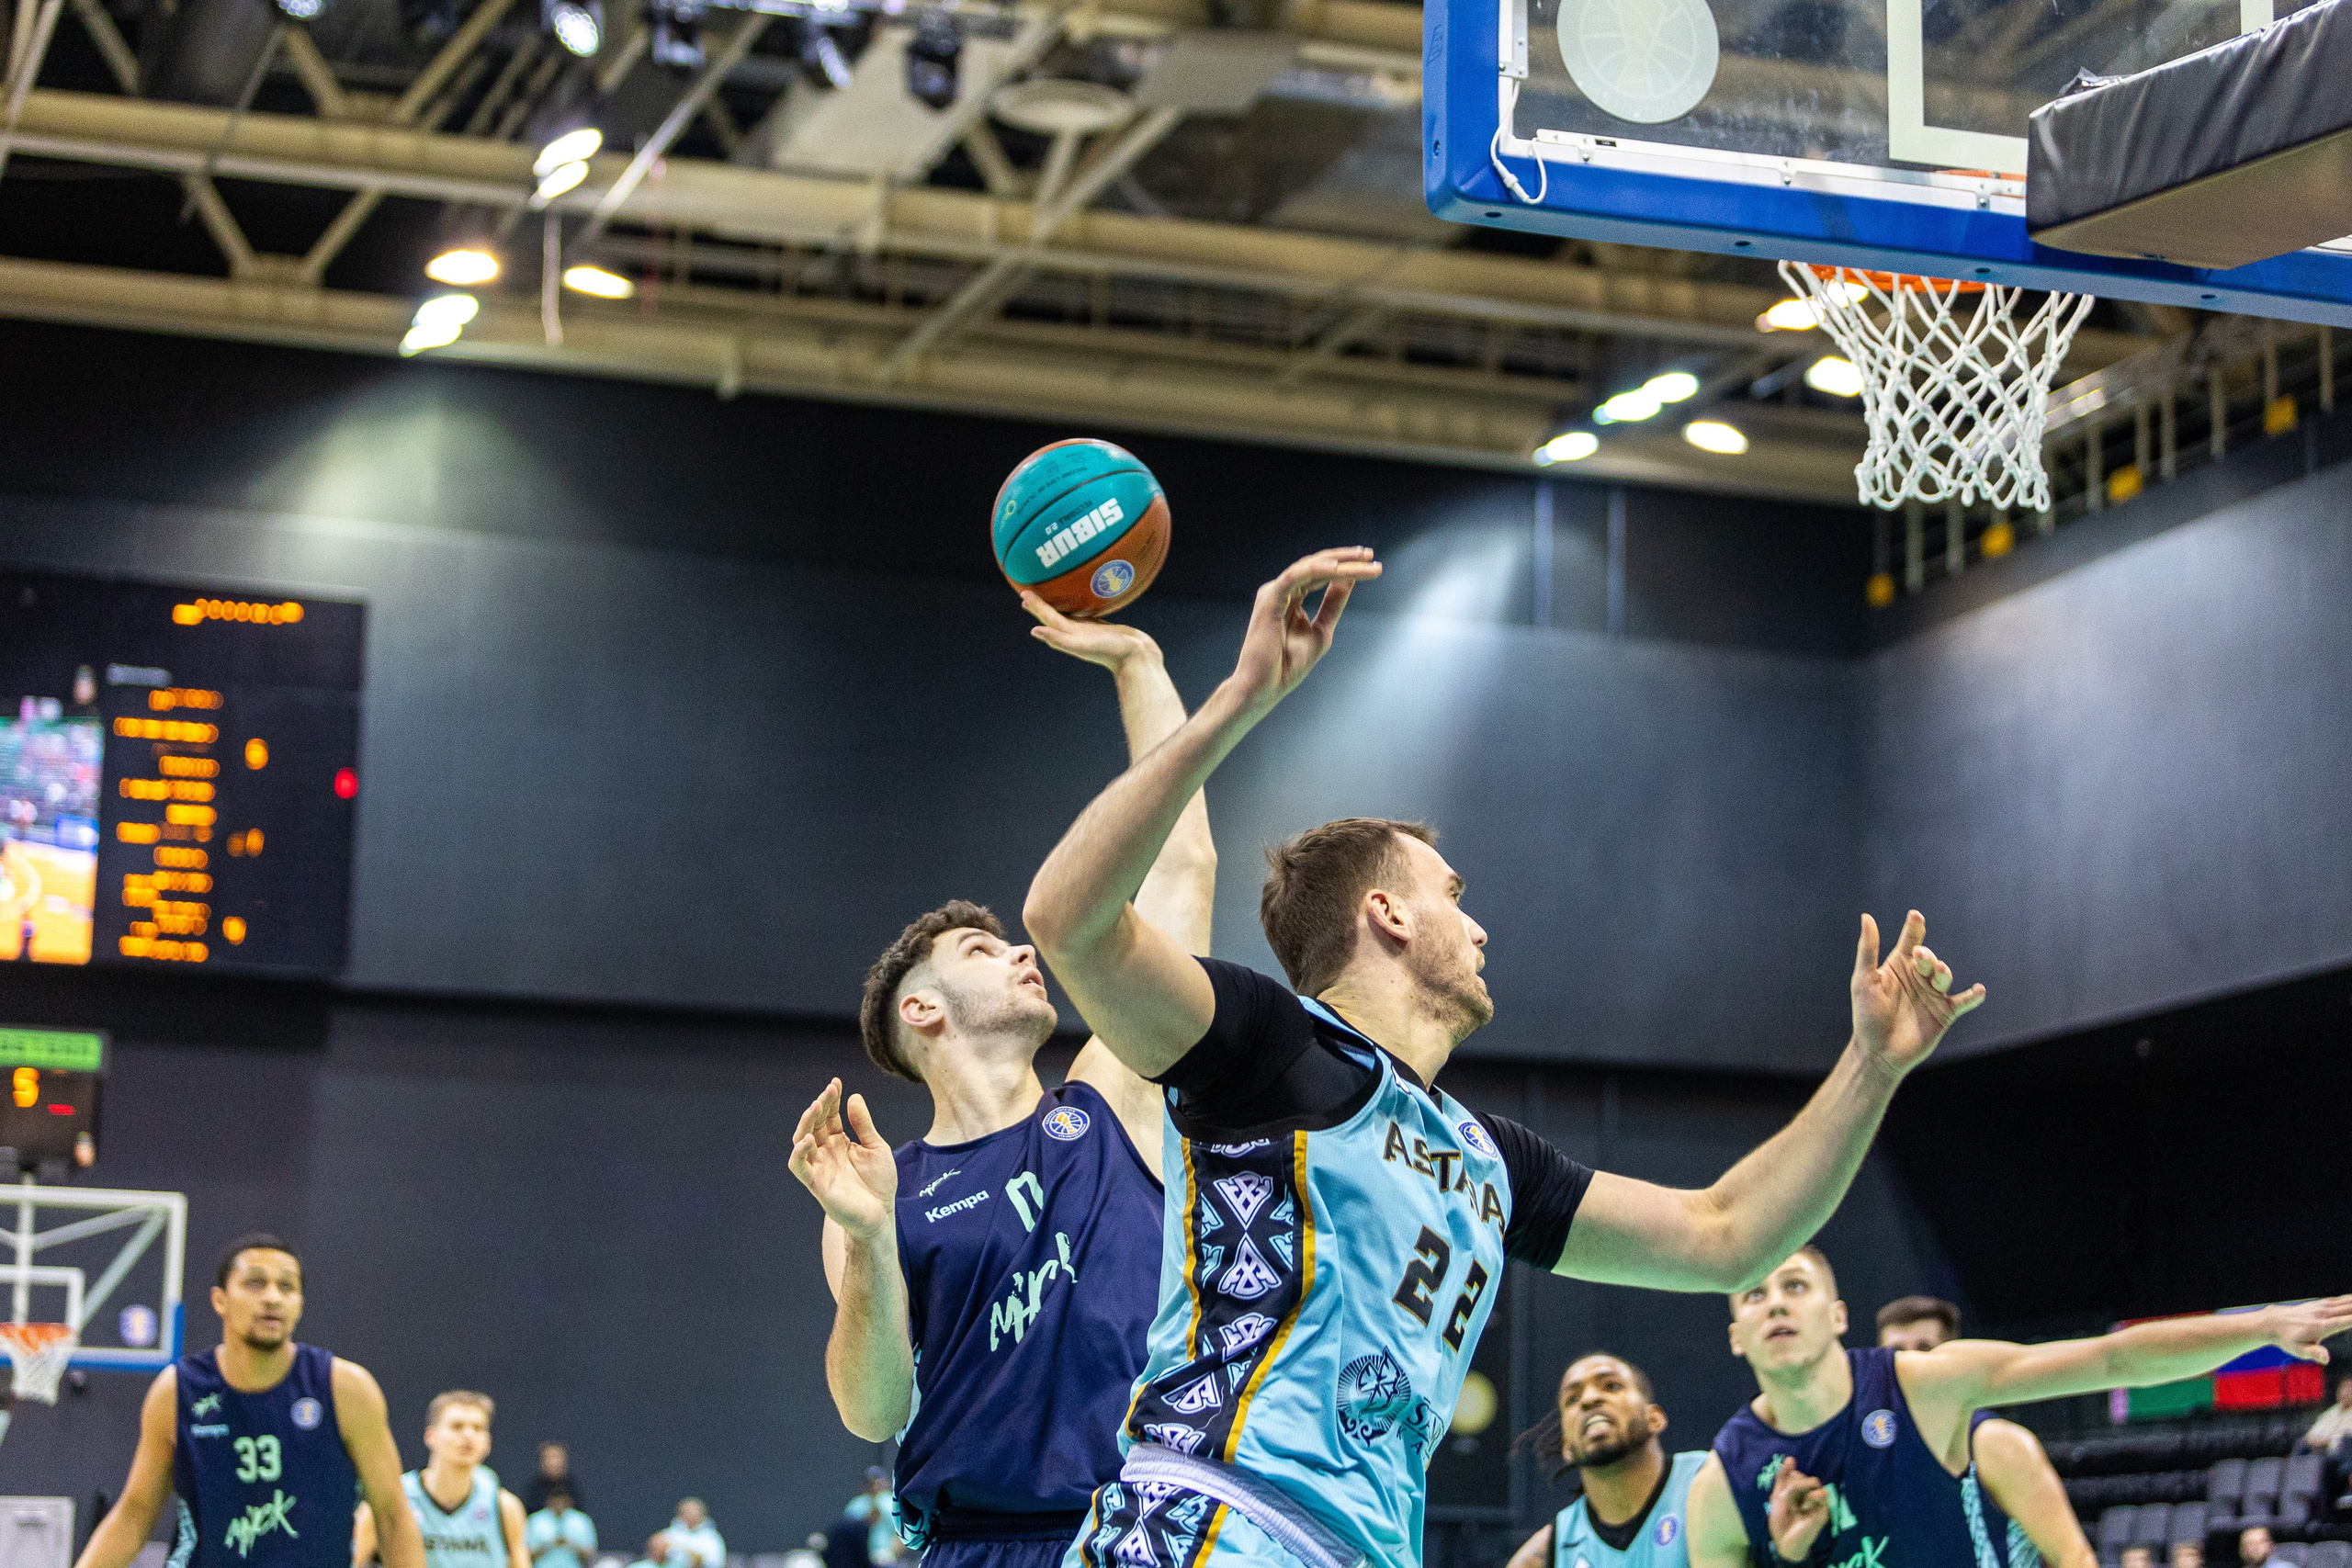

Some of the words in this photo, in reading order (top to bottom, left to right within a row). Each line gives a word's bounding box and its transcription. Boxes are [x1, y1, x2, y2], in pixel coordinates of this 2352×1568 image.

[1035, 497, 1124, 569] SIBUR
[1045, 522, 1058, 535] 2.0
[924, 1190, 990, 1224] Kempa
[1391, 1224, 1488, 1355] 22
[233, 1435, 283, 1483] 33
